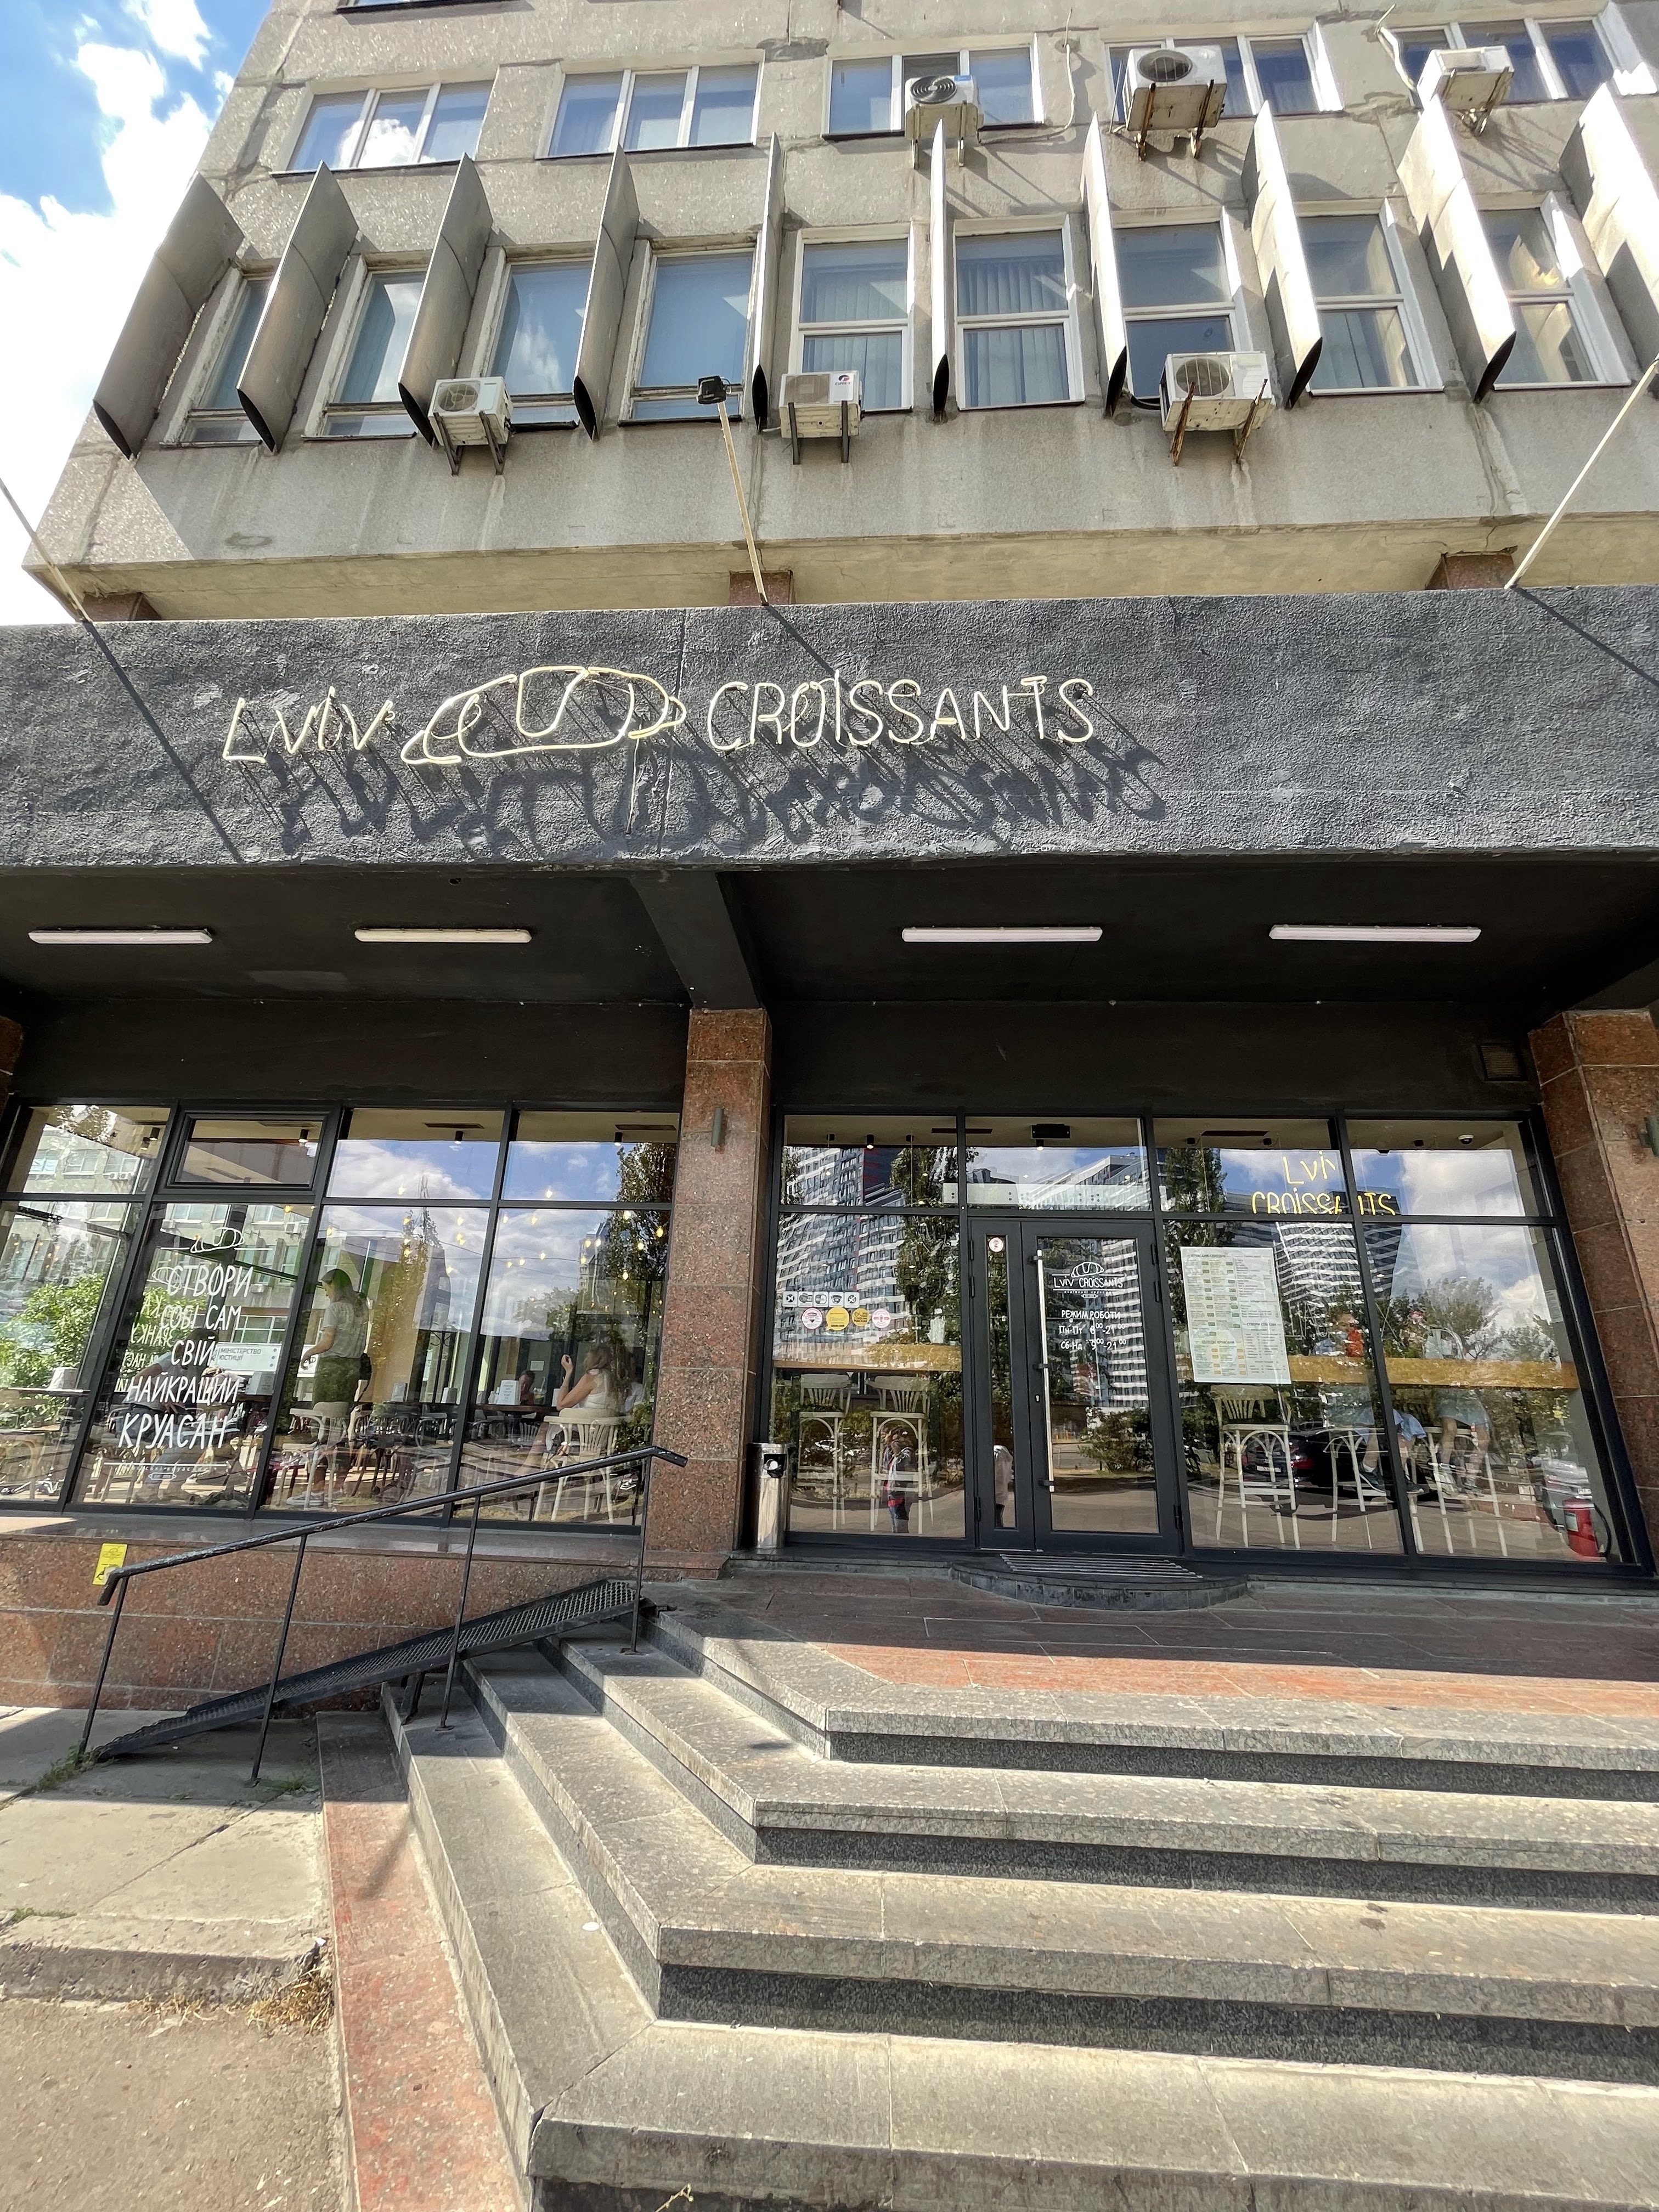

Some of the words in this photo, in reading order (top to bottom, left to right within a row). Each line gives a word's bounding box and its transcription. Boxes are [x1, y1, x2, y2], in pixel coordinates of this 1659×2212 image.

[167, 1264, 253, 1297] СТВОРИ
[161, 1304, 199, 1330] СОБІ
[205, 1305, 242, 1330] САМ
[1062, 1310, 1088, 1319] РЕЖИМ
[1090, 1310, 1120, 1319] РОБОТИ
[1059, 1325, 1082, 1334] Пн-Пт
[171, 1336, 216, 1366] СВІЙ
[1060, 1341, 1082, 1350] Сб-Нд
[118, 1412, 228, 1457] КРУАСАН
